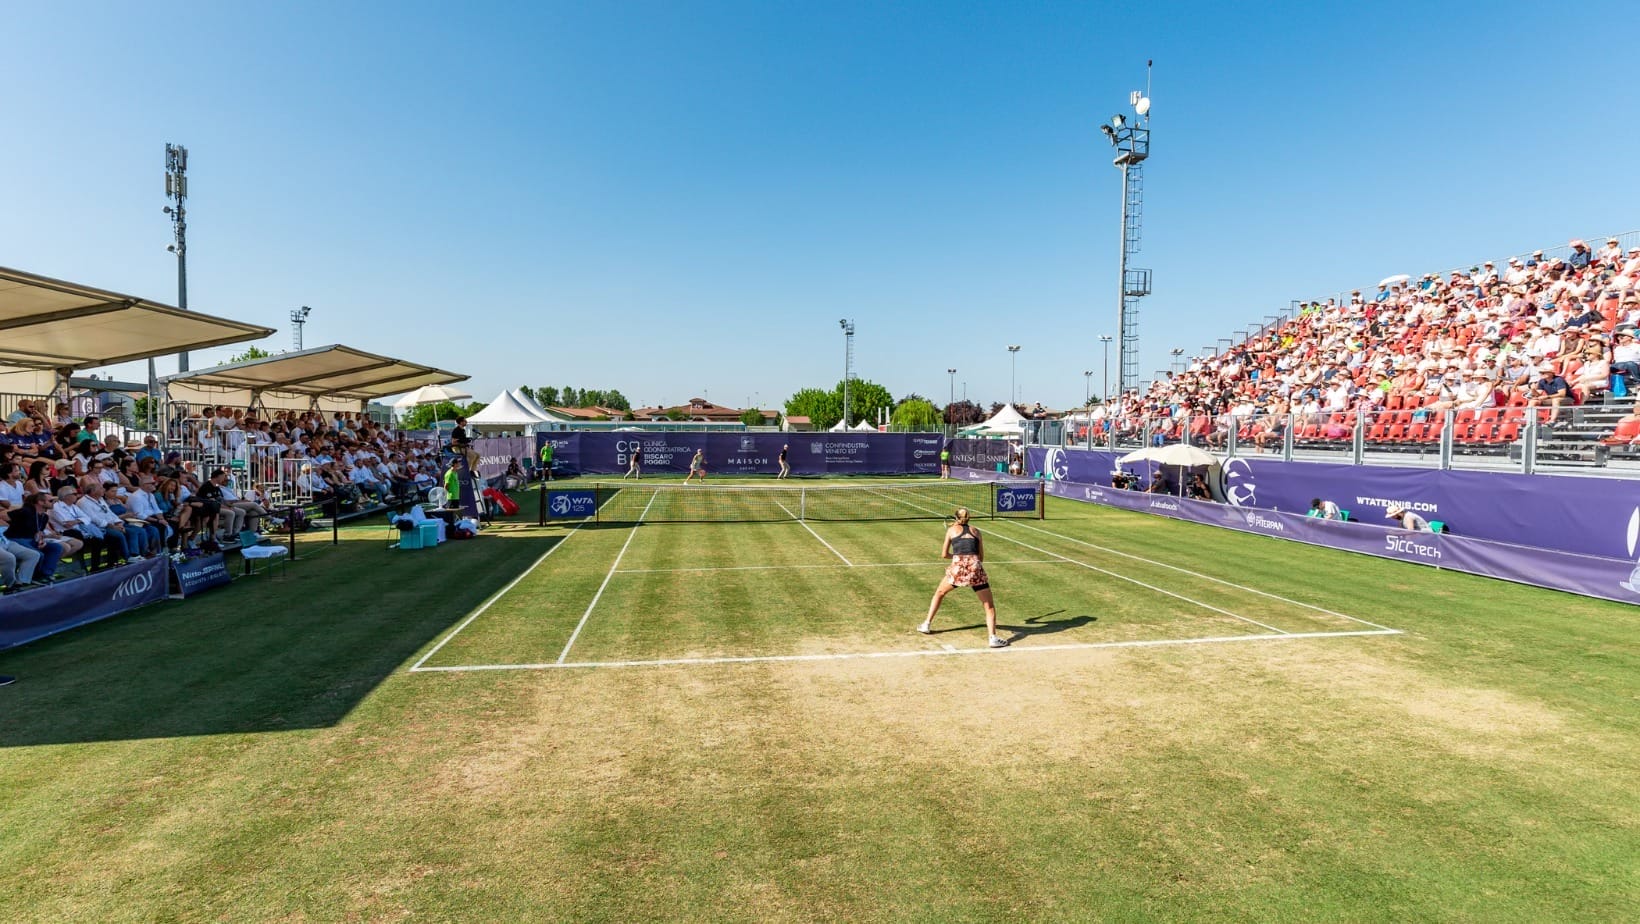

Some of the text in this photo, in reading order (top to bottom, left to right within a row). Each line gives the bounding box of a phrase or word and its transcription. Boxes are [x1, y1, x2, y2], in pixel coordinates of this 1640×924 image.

[572, 497, 594, 505] WTA
[1016, 493, 1035, 501] WTA
[1356, 496, 1438, 513] WTATENNIS.COM
[1255, 518, 1284, 531] PITERPAN
